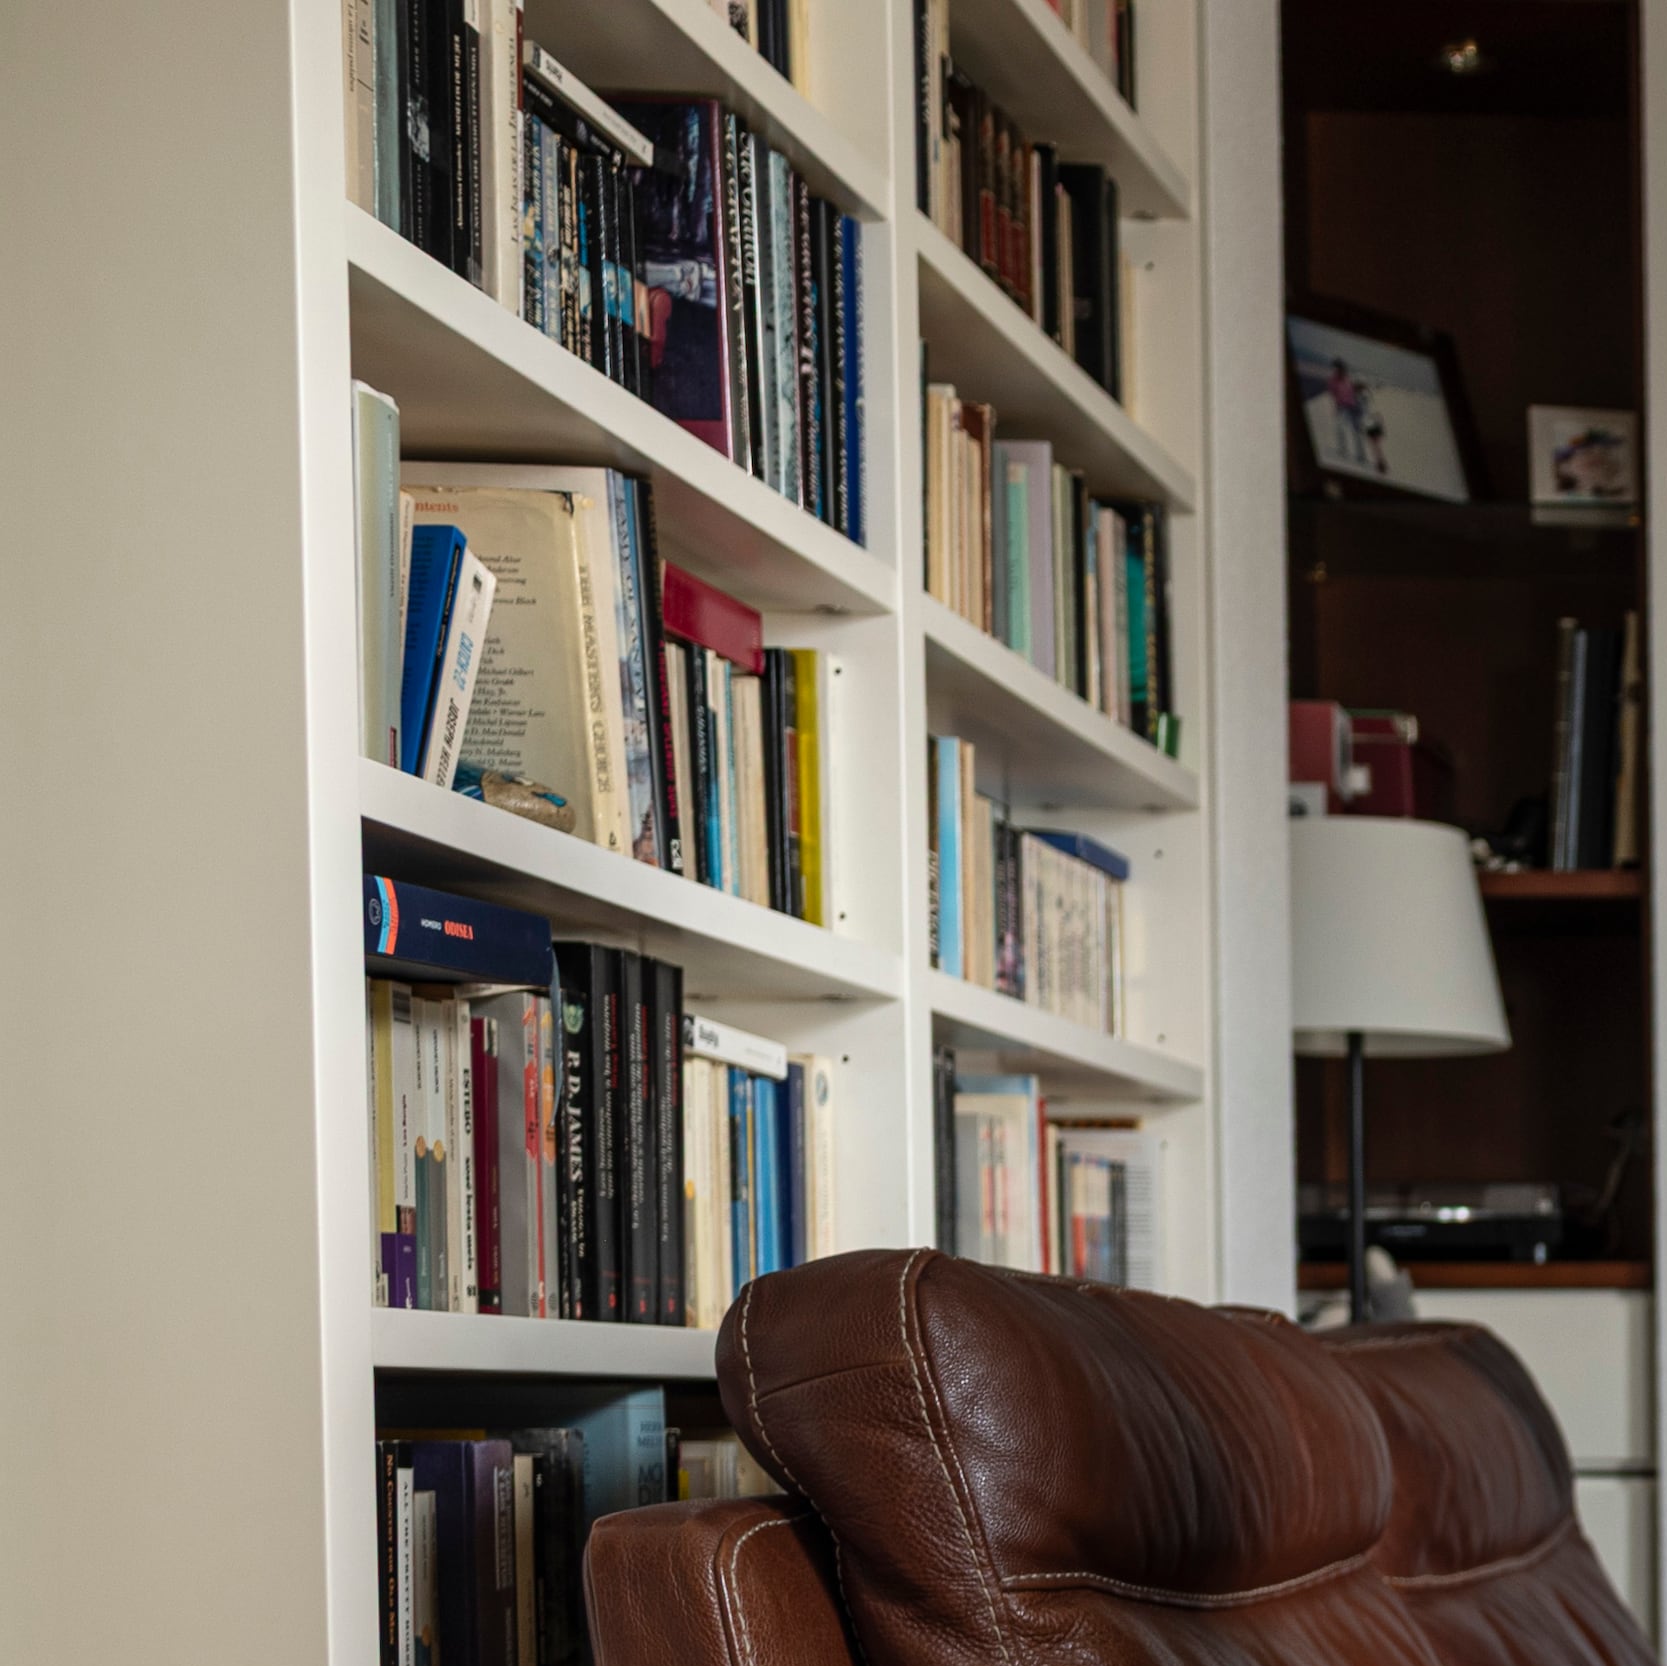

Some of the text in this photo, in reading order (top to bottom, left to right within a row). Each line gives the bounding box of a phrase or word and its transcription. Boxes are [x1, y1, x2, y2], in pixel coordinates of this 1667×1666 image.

[415, 501, 459, 513] ntents
[443, 698, 459, 748] JOSEPH
[444, 920, 474, 941] ODISEA
[567, 1073, 583, 1098] D.
[566, 1104, 583, 1183] JAMES
